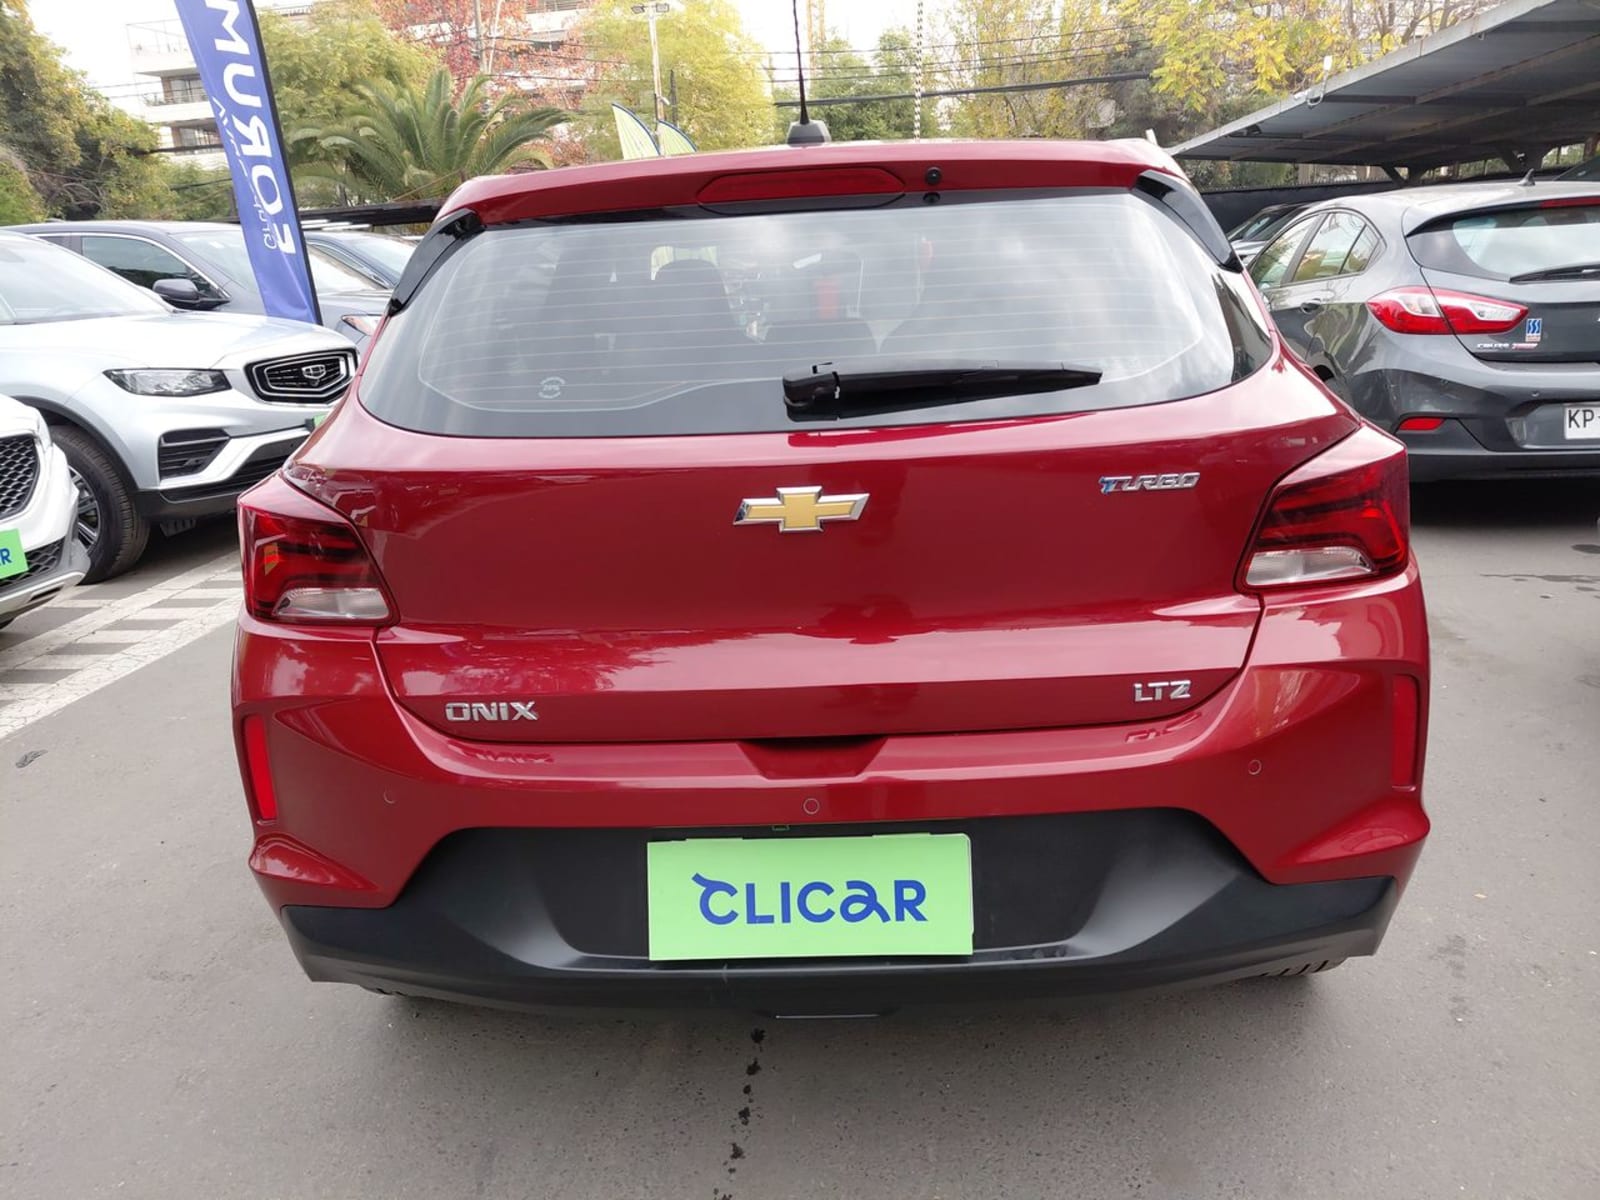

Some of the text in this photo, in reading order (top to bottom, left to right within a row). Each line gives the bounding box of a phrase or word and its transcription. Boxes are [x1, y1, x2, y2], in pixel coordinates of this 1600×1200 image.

[1099, 472, 1200, 494] TURBO
[0, 547, 12, 565] R
[1133, 680, 1191, 702] LTZ
[446, 701, 539, 721] ONIX
